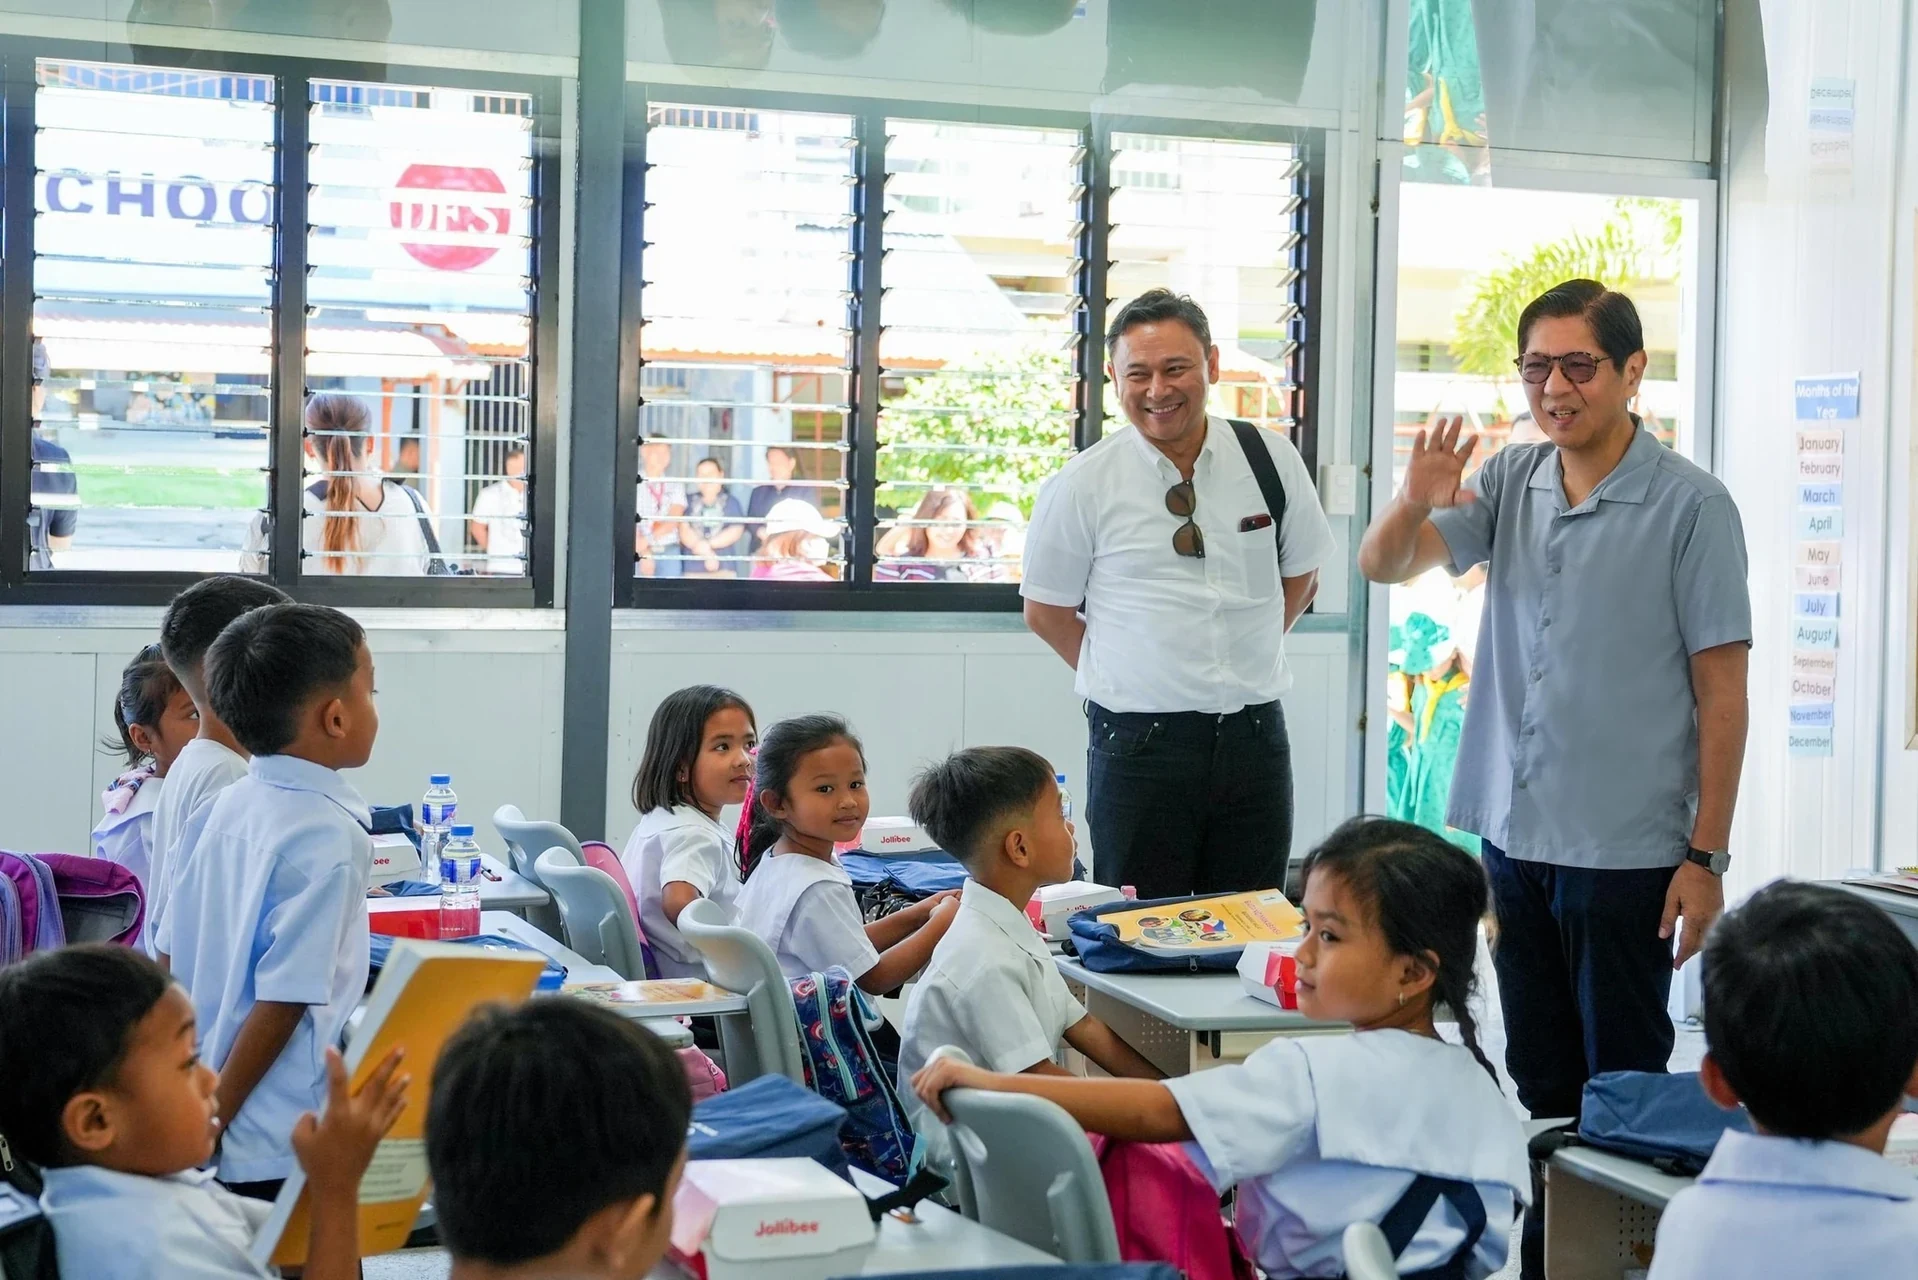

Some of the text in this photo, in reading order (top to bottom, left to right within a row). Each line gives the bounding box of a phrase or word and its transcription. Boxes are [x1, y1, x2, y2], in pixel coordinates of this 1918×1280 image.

[1796, 382, 1858, 398] Months of the
[1816, 406, 1839, 419] Year
[1799, 436, 1840, 453] January
[1800, 461, 1841, 478] February
[1802, 489, 1836, 503] March
[1808, 515, 1833, 533] April
[1807, 547, 1830, 564] May
[1807, 573, 1830, 586] June
[1804, 599, 1827, 616] July
[1796, 625, 1832, 644] August
[1792, 655, 1835, 669] September
[1792, 679, 1832, 697] October
[1790, 708, 1832, 722] November
[1788, 735, 1831, 748] December
[880, 835, 911, 844] Jollibee
[754, 1218, 820, 1237] Jollibee
